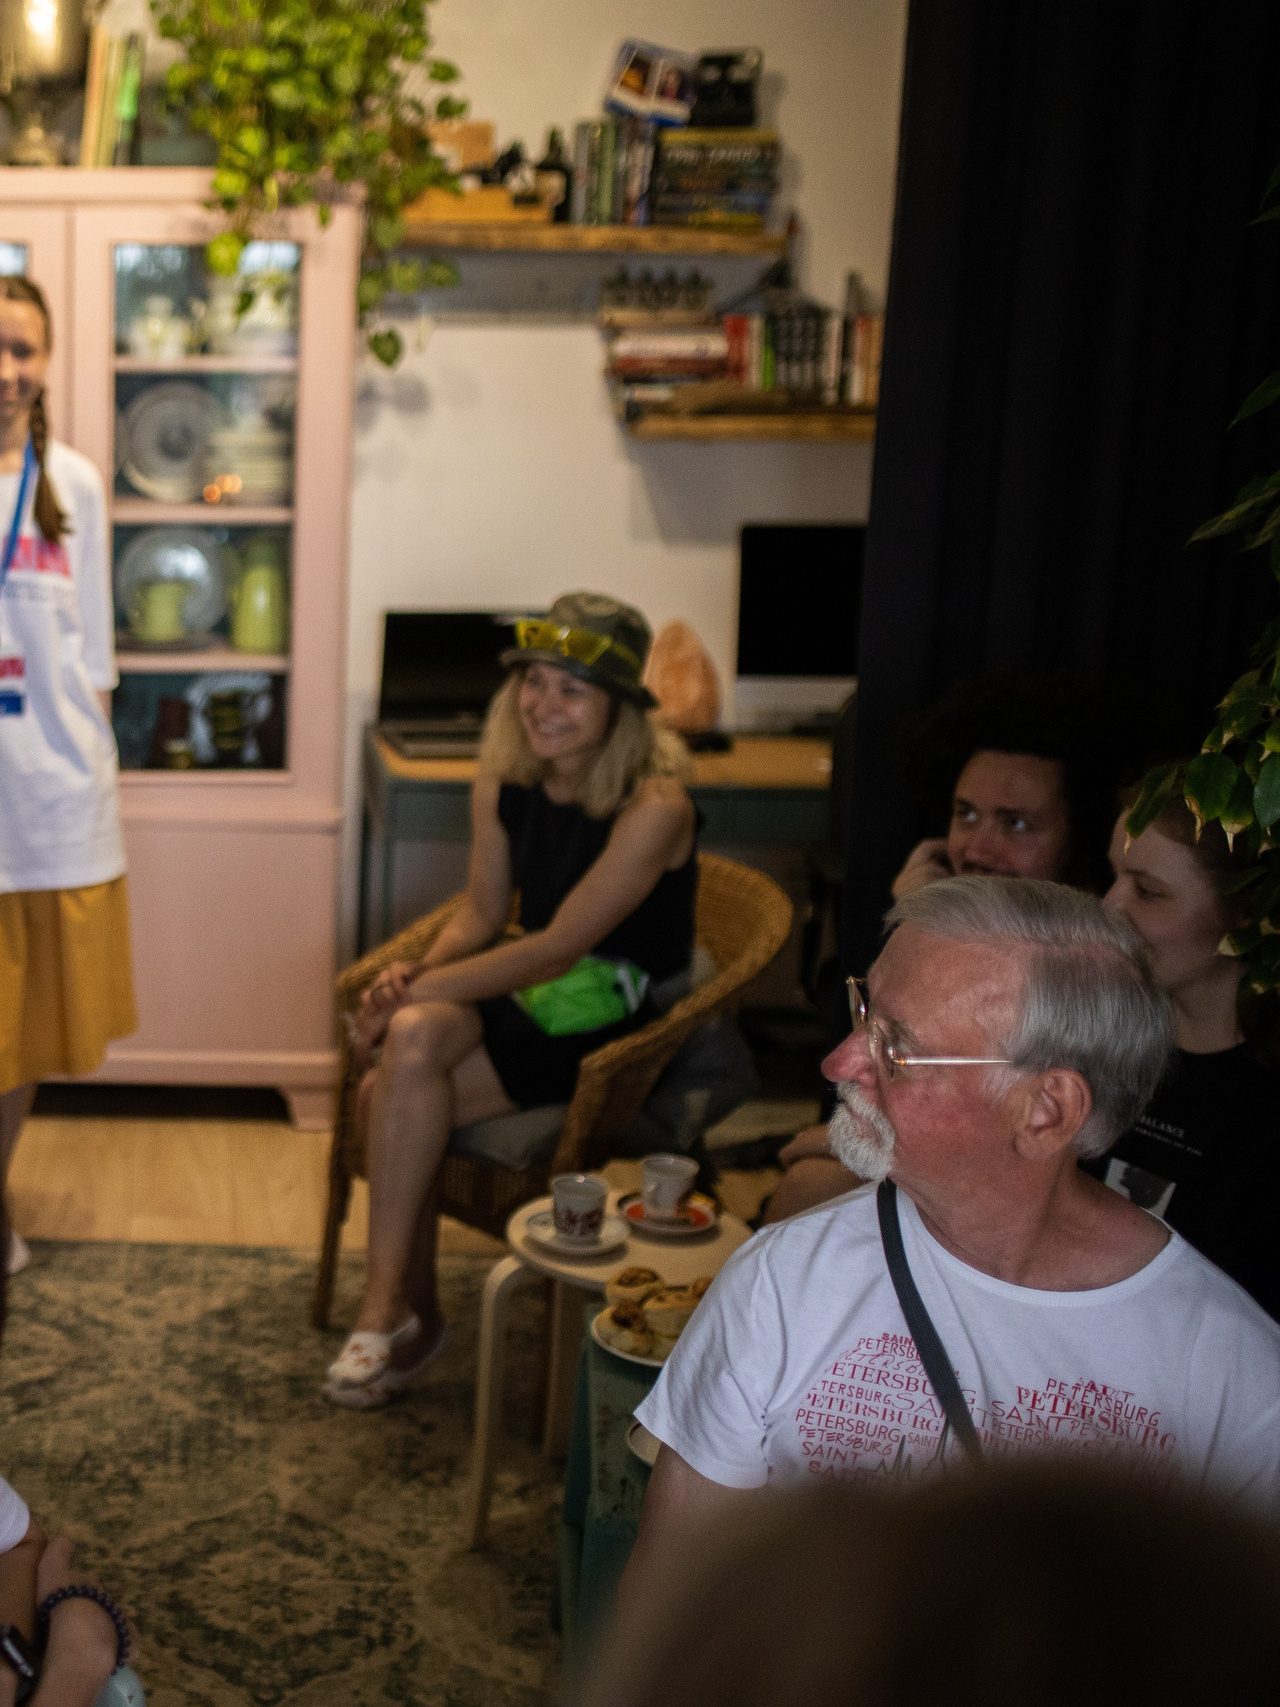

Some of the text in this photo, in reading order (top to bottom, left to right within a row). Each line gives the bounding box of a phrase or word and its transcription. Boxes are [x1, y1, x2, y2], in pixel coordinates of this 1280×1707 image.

[857, 1337, 922, 1361] PETERSB
[881, 1332, 916, 1346] SAIN
[811, 1380, 893, 1406] TERSBURG
[1046, 1377, 1162, 1428] PETERSBURG
[795, 1408, 902, 1443] PETERSBURG
[991, 1400, 1073, 1433] SAINT
[798, 1425, 893, 1456] PETERSBURG
[907, 1431, 940, 1448] SAINT
[801, 1441, 863, 1467] SAINT
